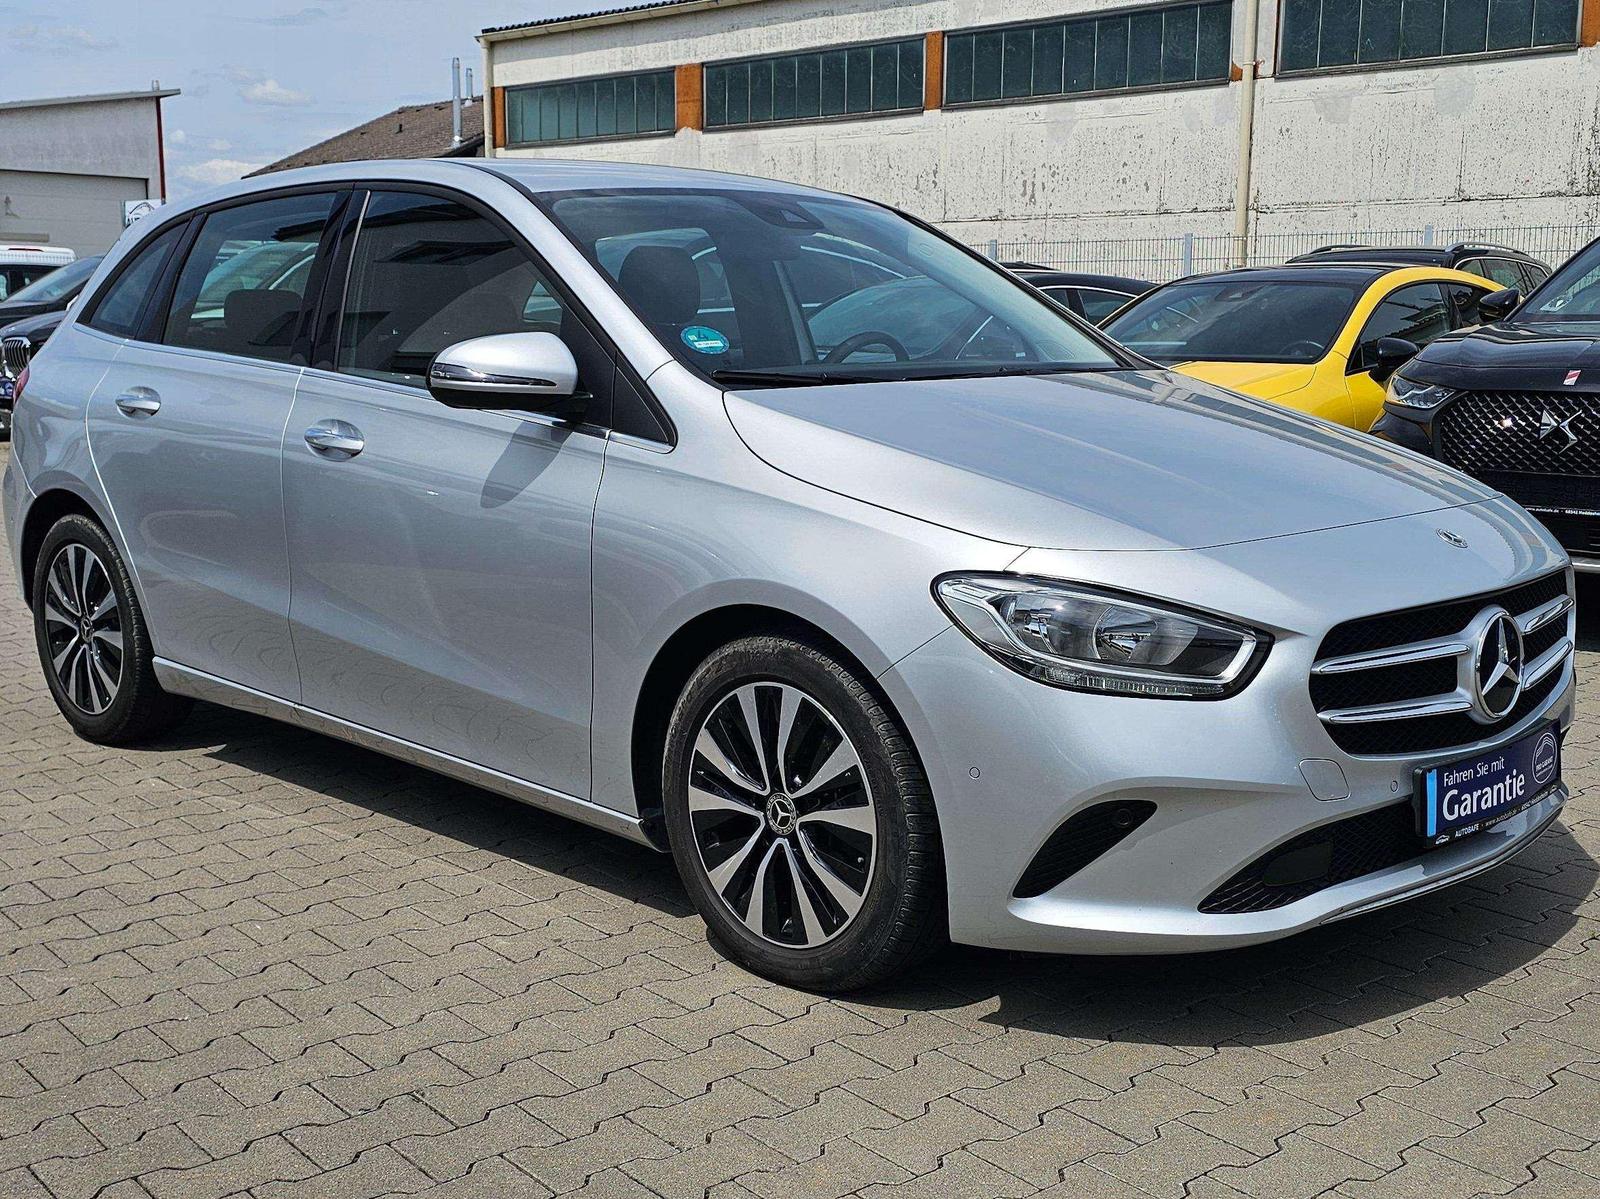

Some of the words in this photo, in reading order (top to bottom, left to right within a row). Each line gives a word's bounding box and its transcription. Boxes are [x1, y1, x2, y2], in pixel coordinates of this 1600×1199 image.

[1443, 768, 1474, 787] Fahren
[1476, 762, 1489, 778] Sie
[1490, 756, 1505, 772] mit
[1443, 769, 1525, 821] Garantie
